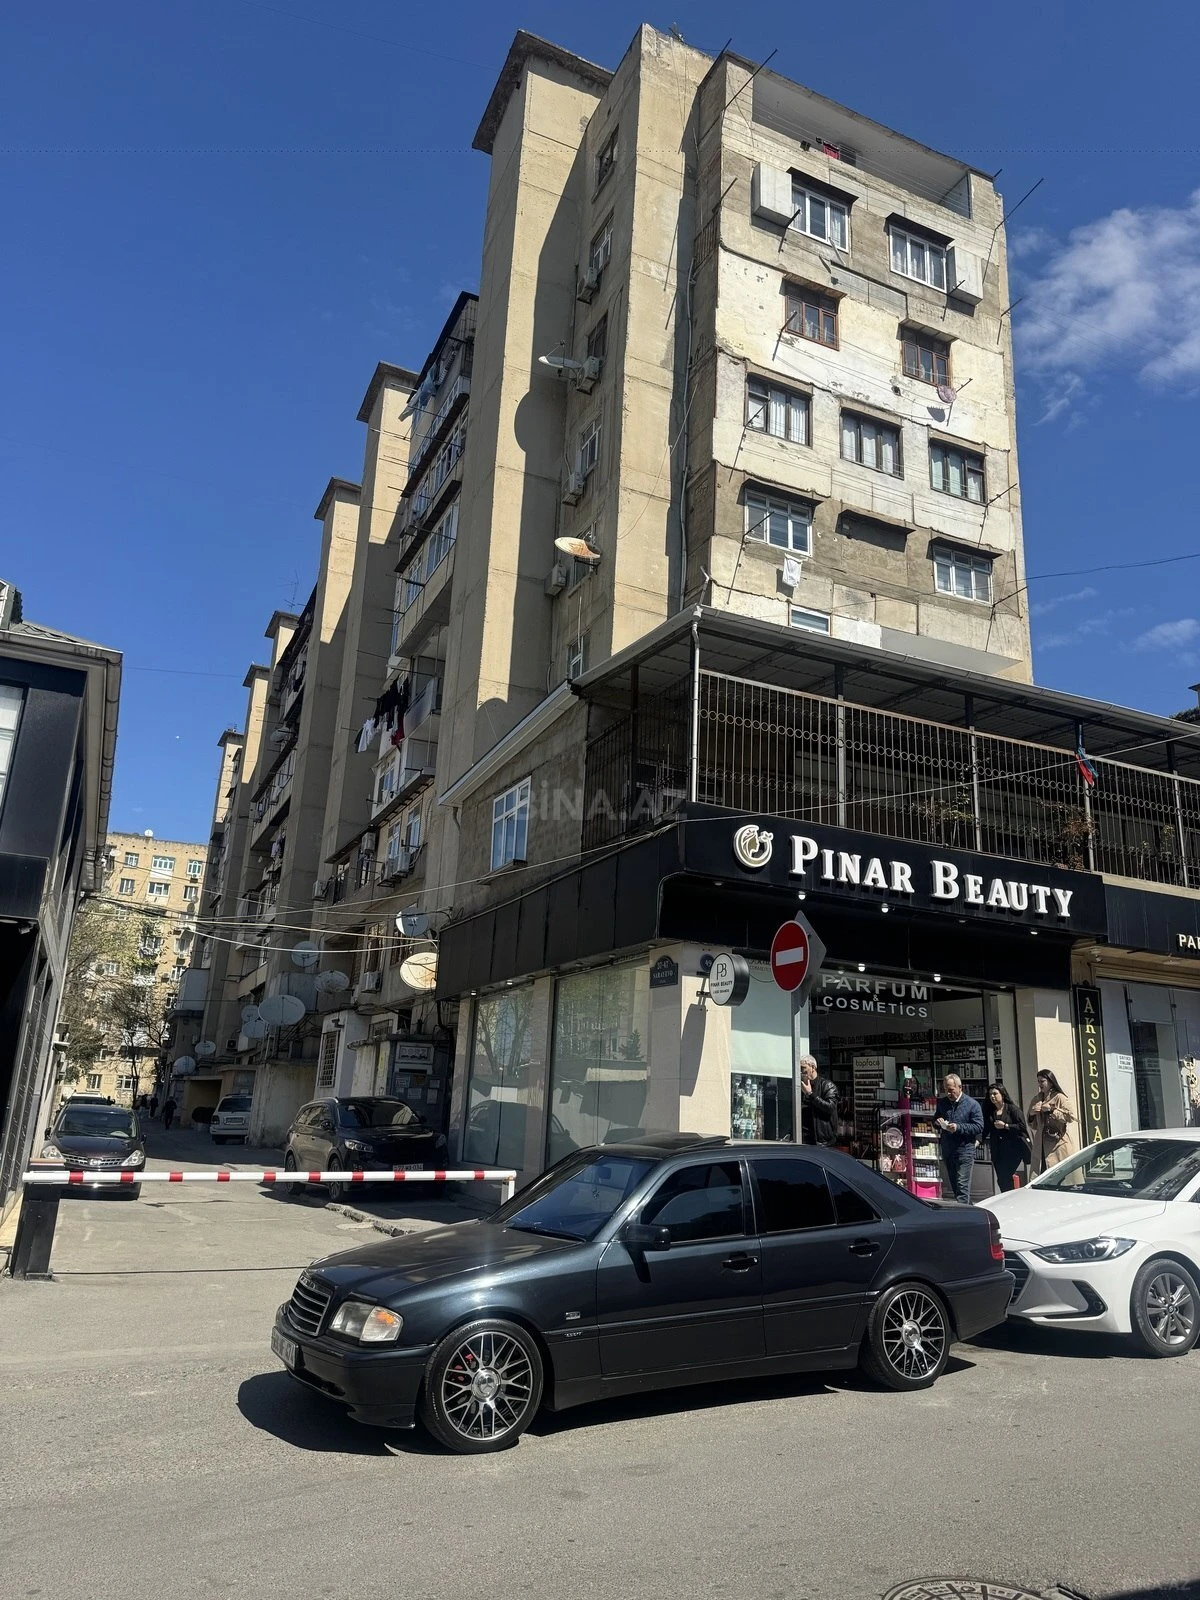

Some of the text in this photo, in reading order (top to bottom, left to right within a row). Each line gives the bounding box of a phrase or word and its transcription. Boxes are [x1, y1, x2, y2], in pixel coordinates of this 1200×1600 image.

[789, 834, 1073, 917] PINAR BEAUTY
[821, 974, 928, 1000] PARFUM
[872, 994, 880, 1002] &
